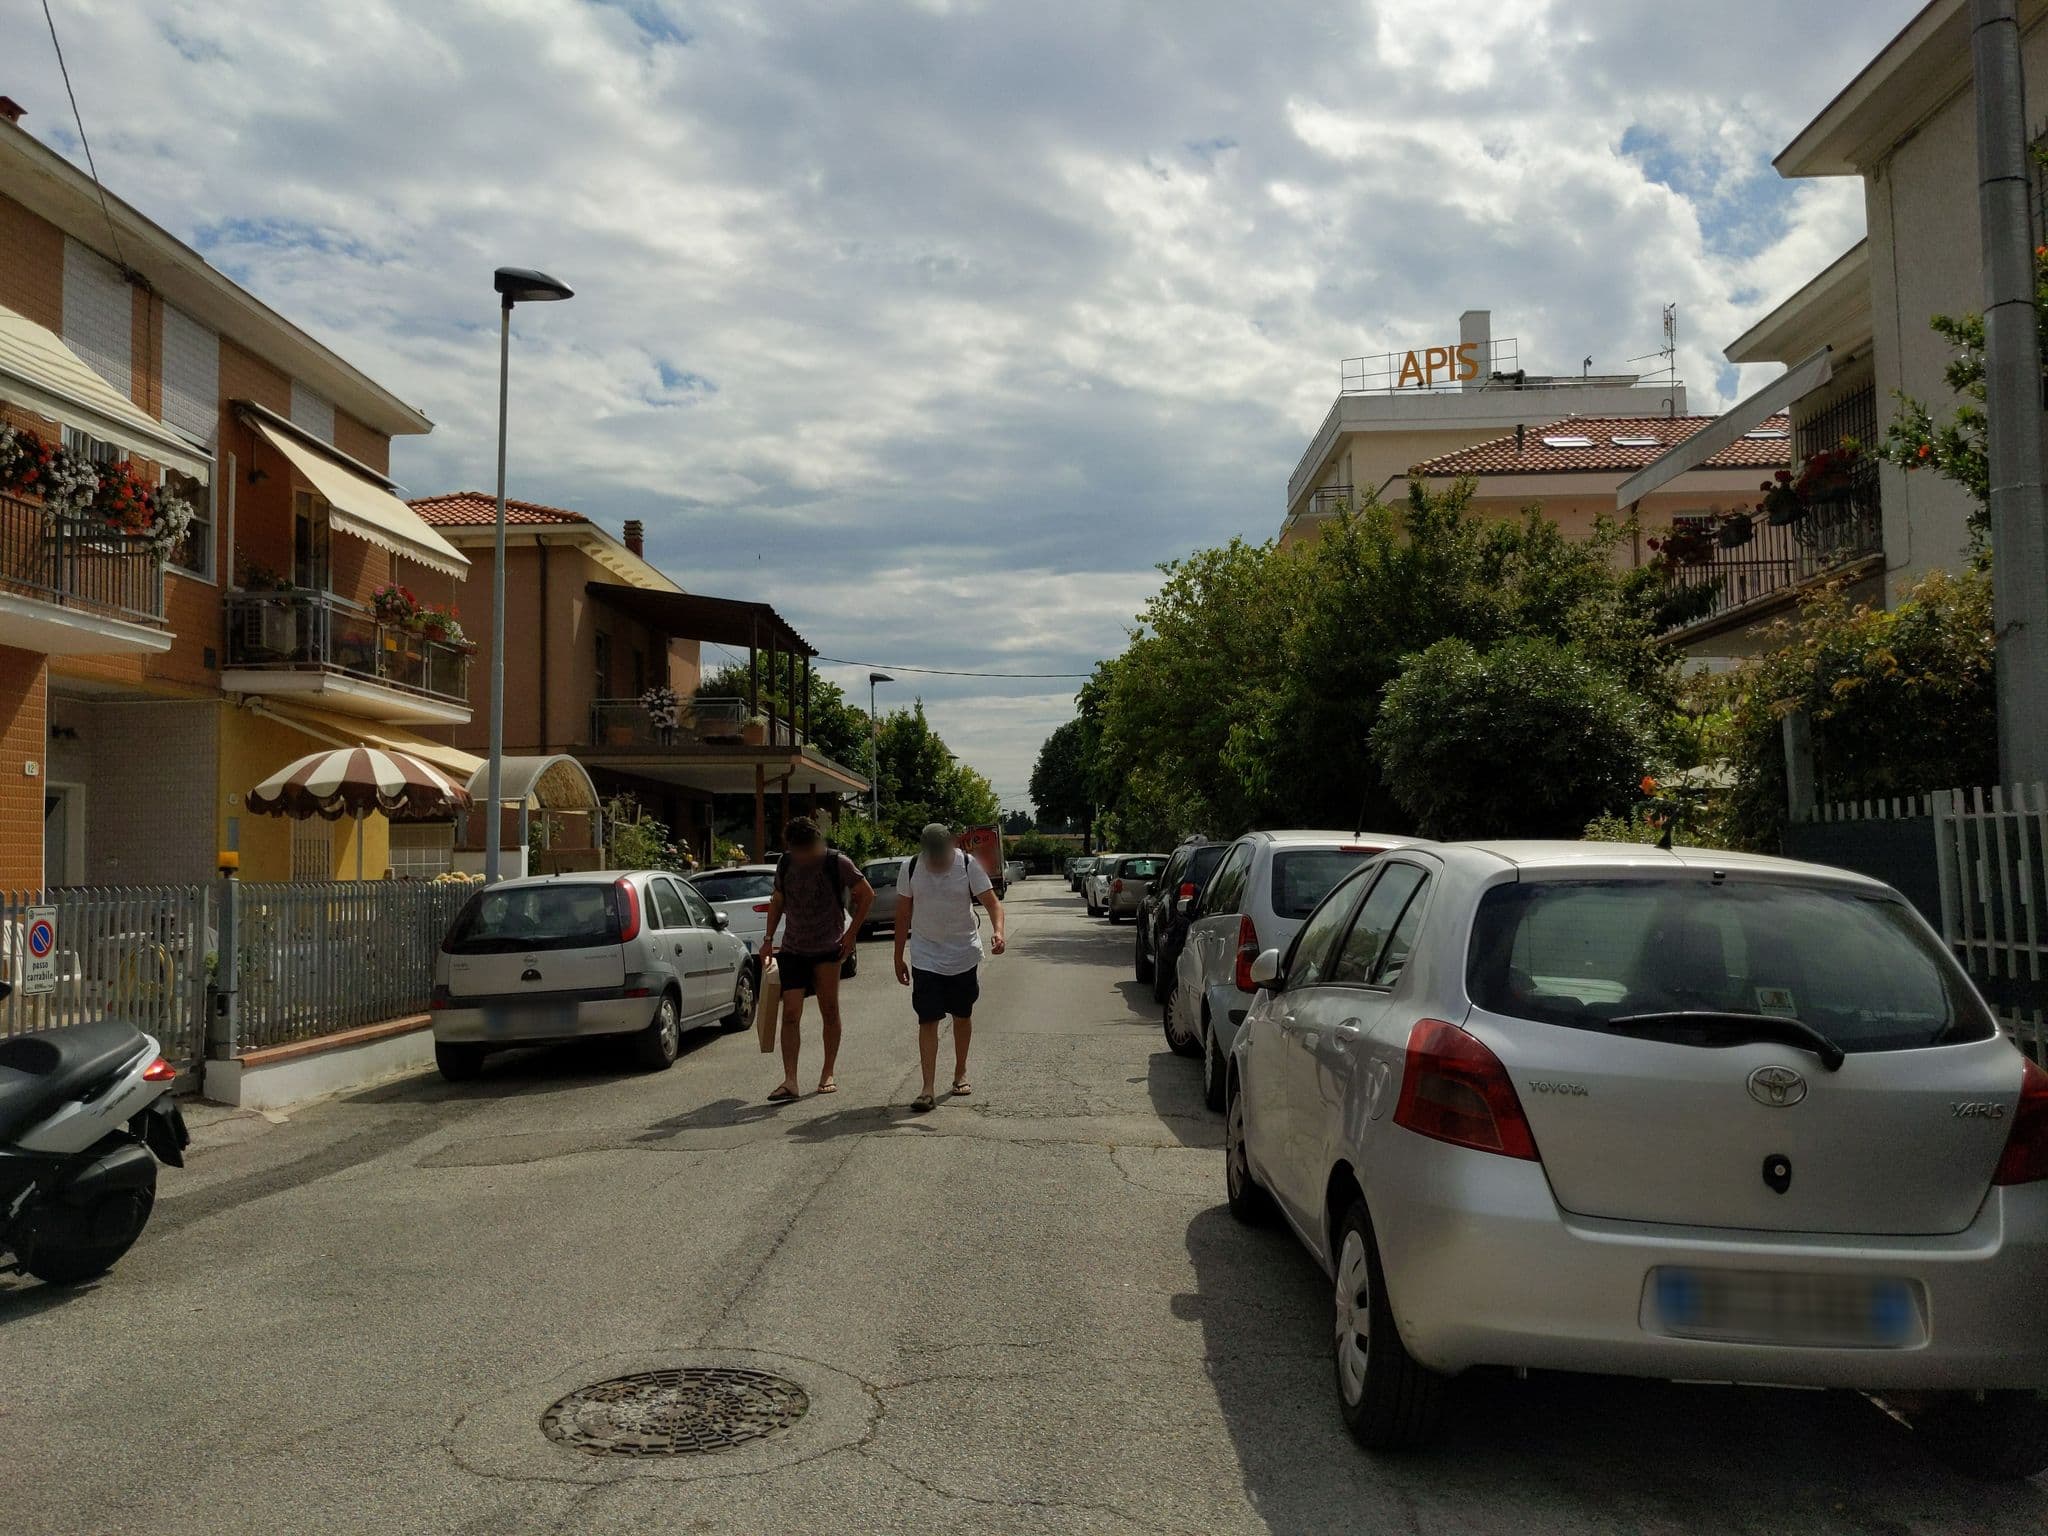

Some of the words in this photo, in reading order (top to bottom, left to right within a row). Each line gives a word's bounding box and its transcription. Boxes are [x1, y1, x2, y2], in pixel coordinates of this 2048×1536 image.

[1397, 343, 1478, 387] APIS
[32, 961, 49, 972] passo
[27, 970, 53, 982] carrabile
[1529, 1081, 1589, 1096] TOYOTA
[1951, 1101, 2005, 1118] YARIS
